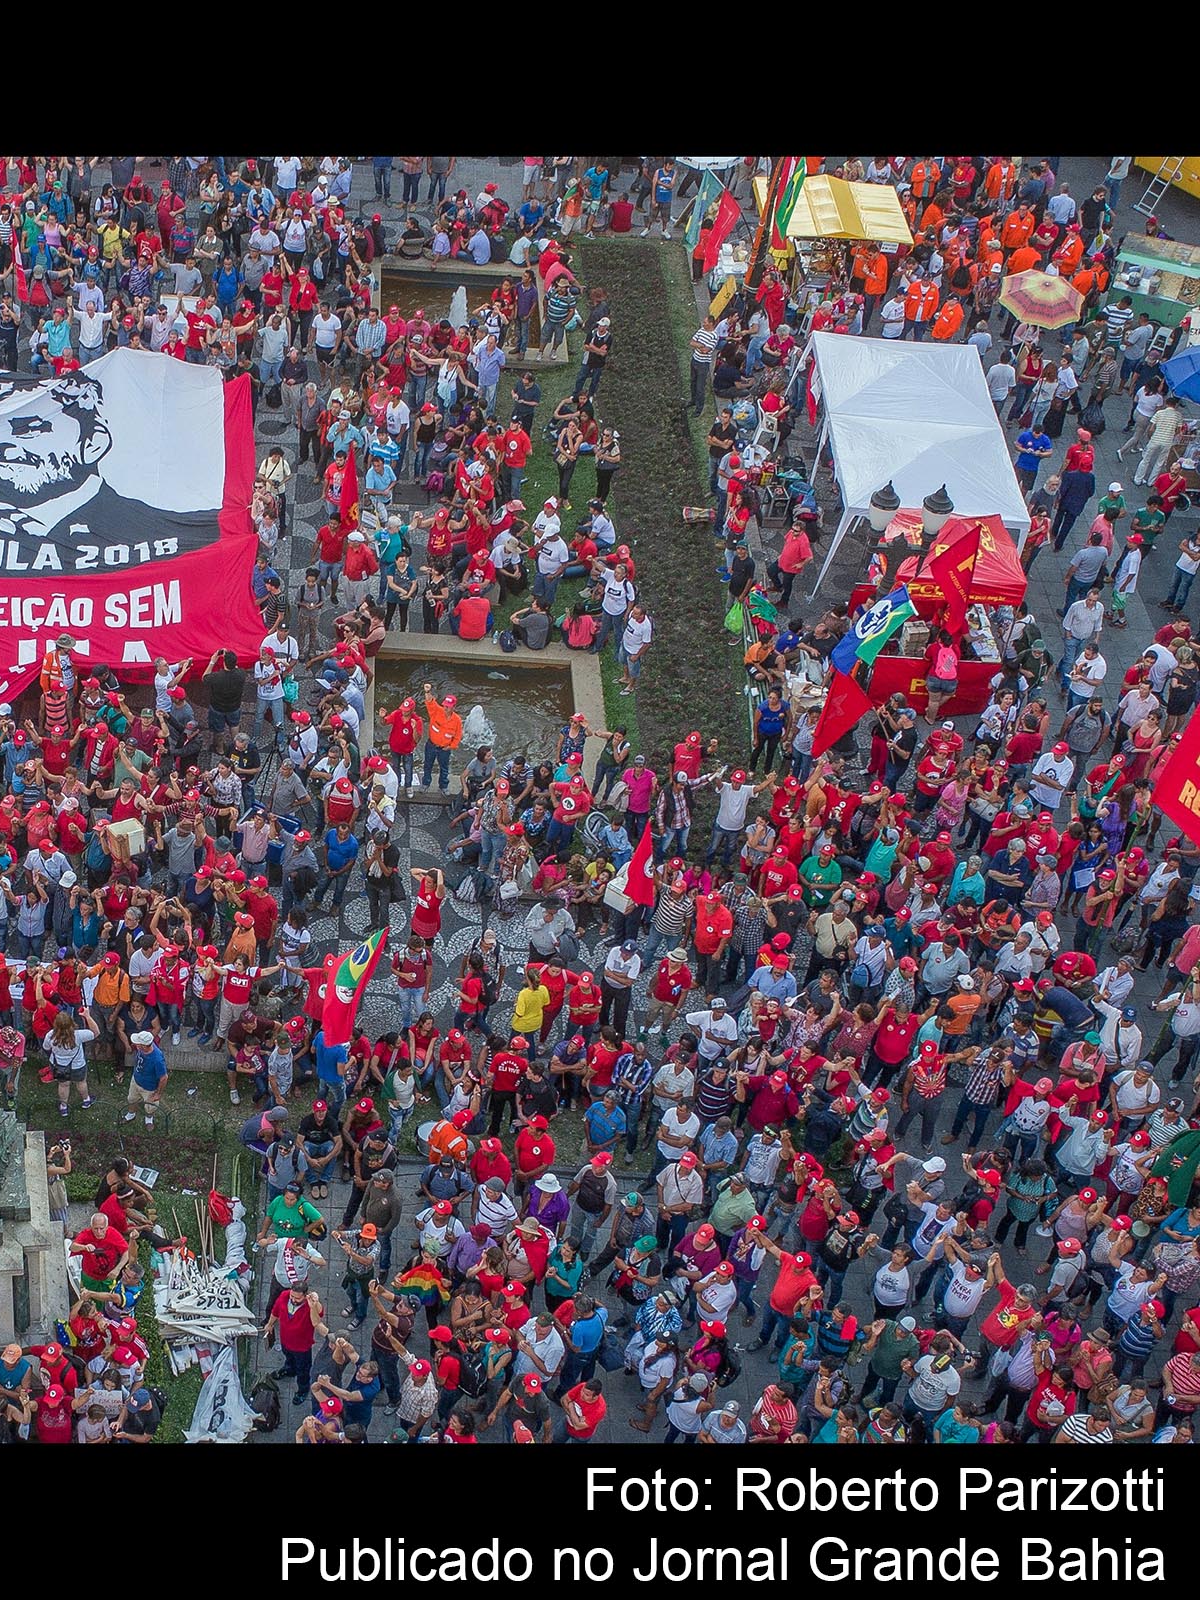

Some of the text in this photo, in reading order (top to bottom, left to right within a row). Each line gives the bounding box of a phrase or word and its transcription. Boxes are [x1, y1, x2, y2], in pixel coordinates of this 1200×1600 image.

[75, 537, 179, 570] 2018
[104, 580, 181, 628] SEM
[229, 976, 248, 987] CUT
